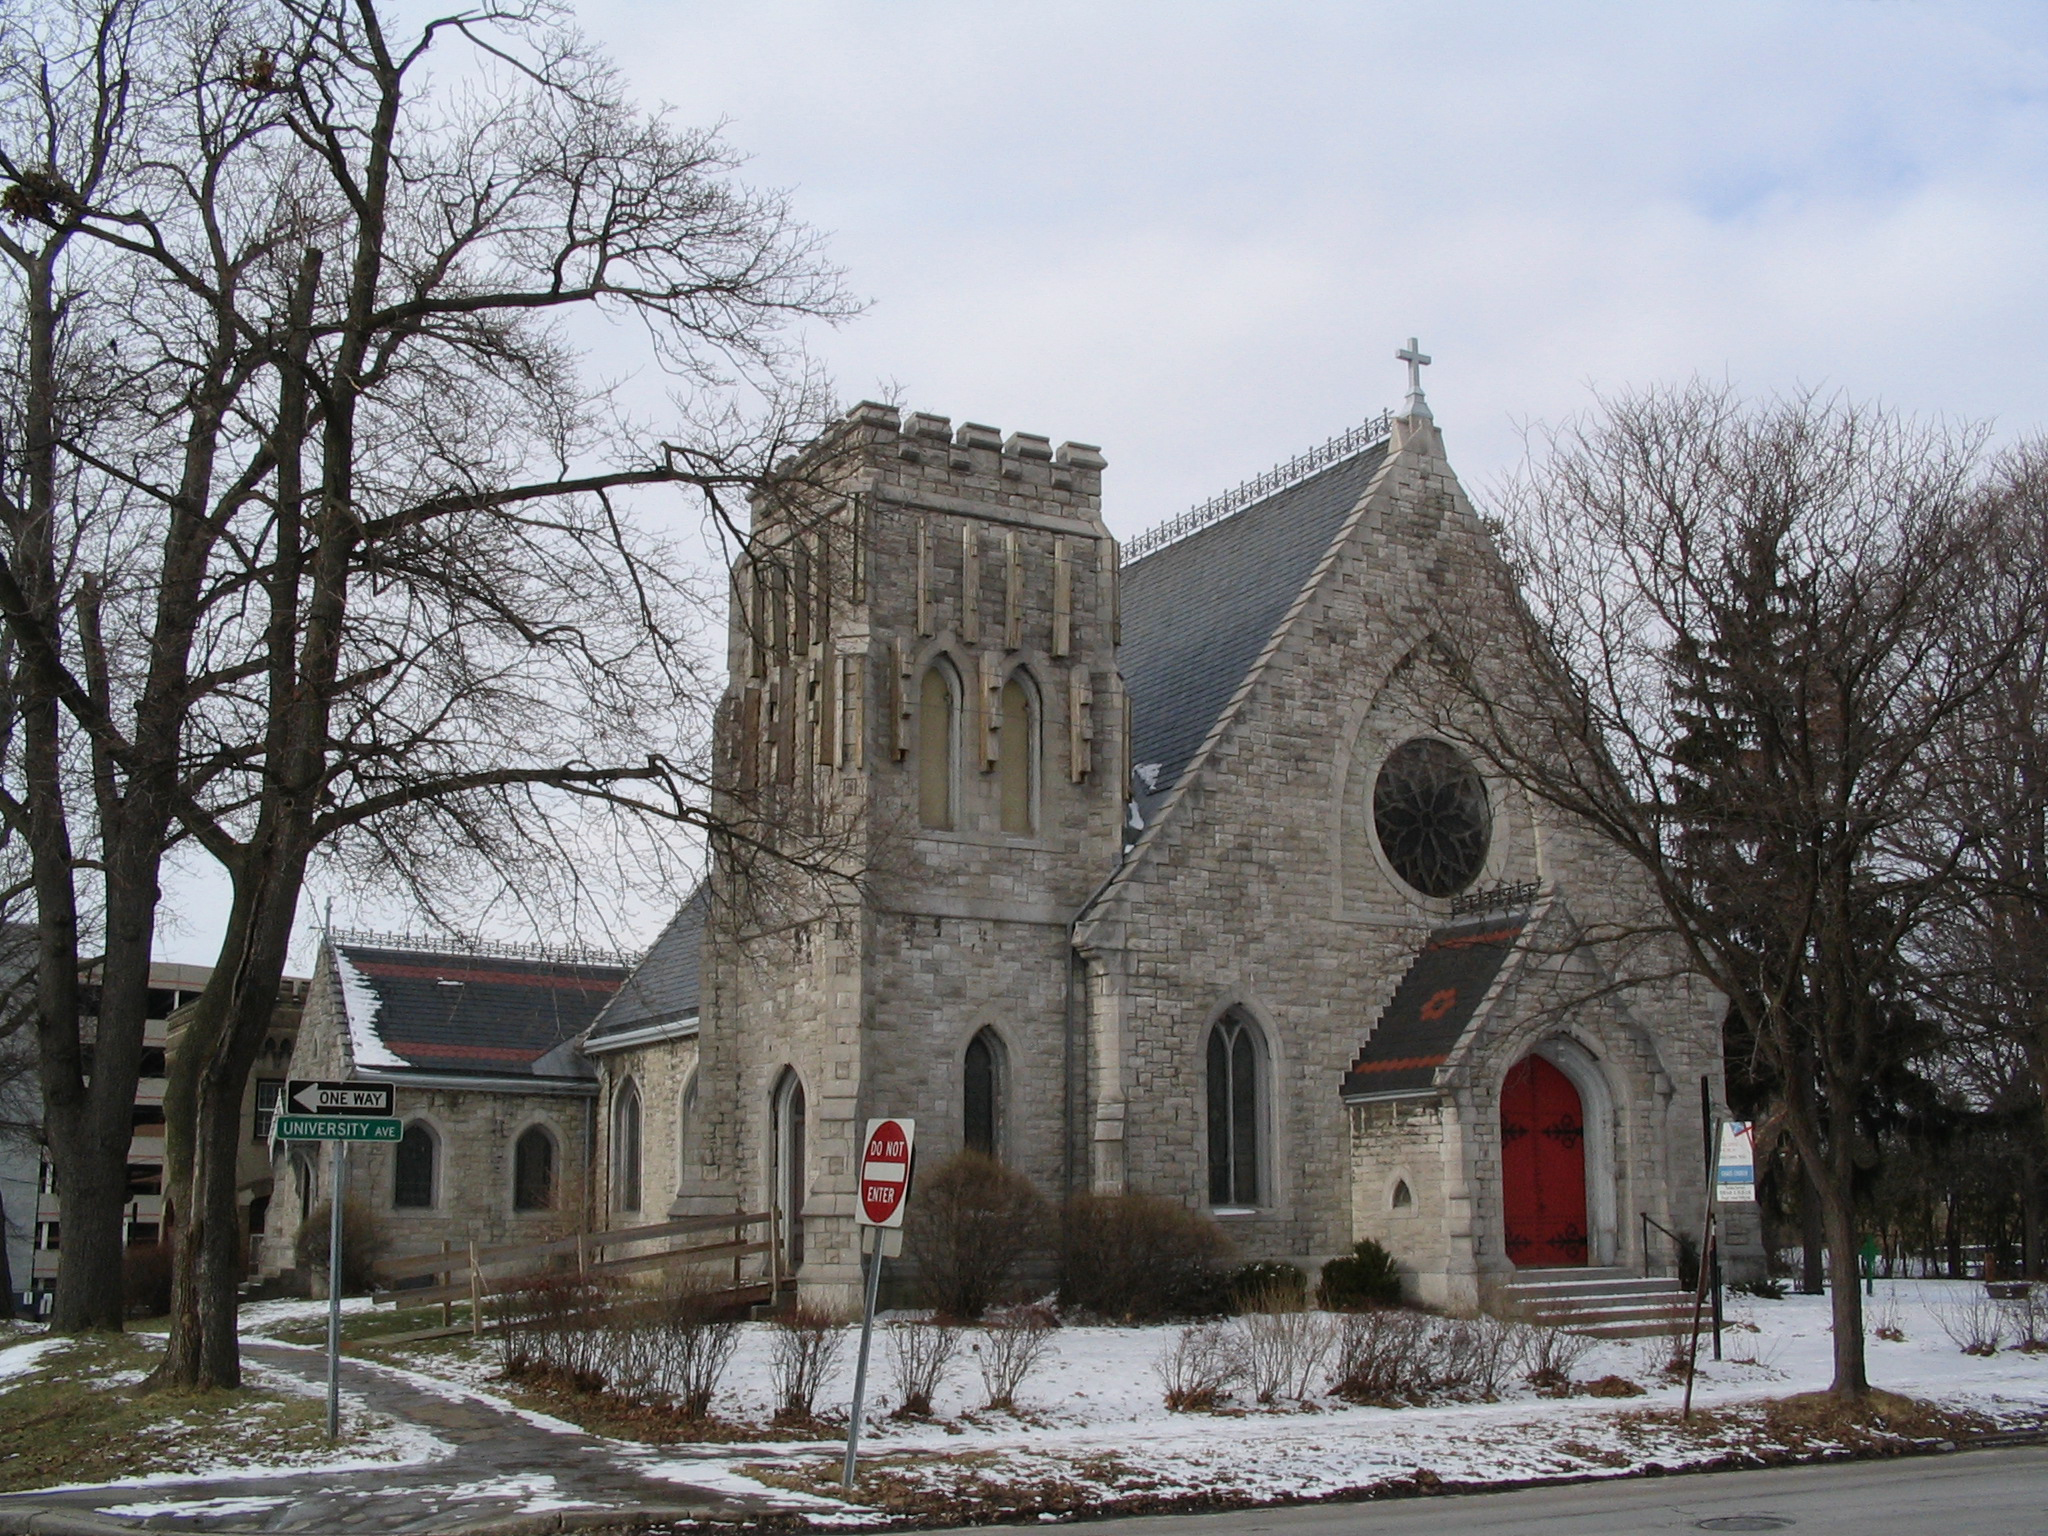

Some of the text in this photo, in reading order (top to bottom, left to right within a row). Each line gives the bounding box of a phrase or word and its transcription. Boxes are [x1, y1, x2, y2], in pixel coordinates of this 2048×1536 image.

[319, 1091, 383, 1106] ONE WAY
[283, 1121, 396, 1137] UNIVERSITY AVE
[870, 1140, 905, 1157] DO NOT
[867, 1186, 895, 1203] ENTER
